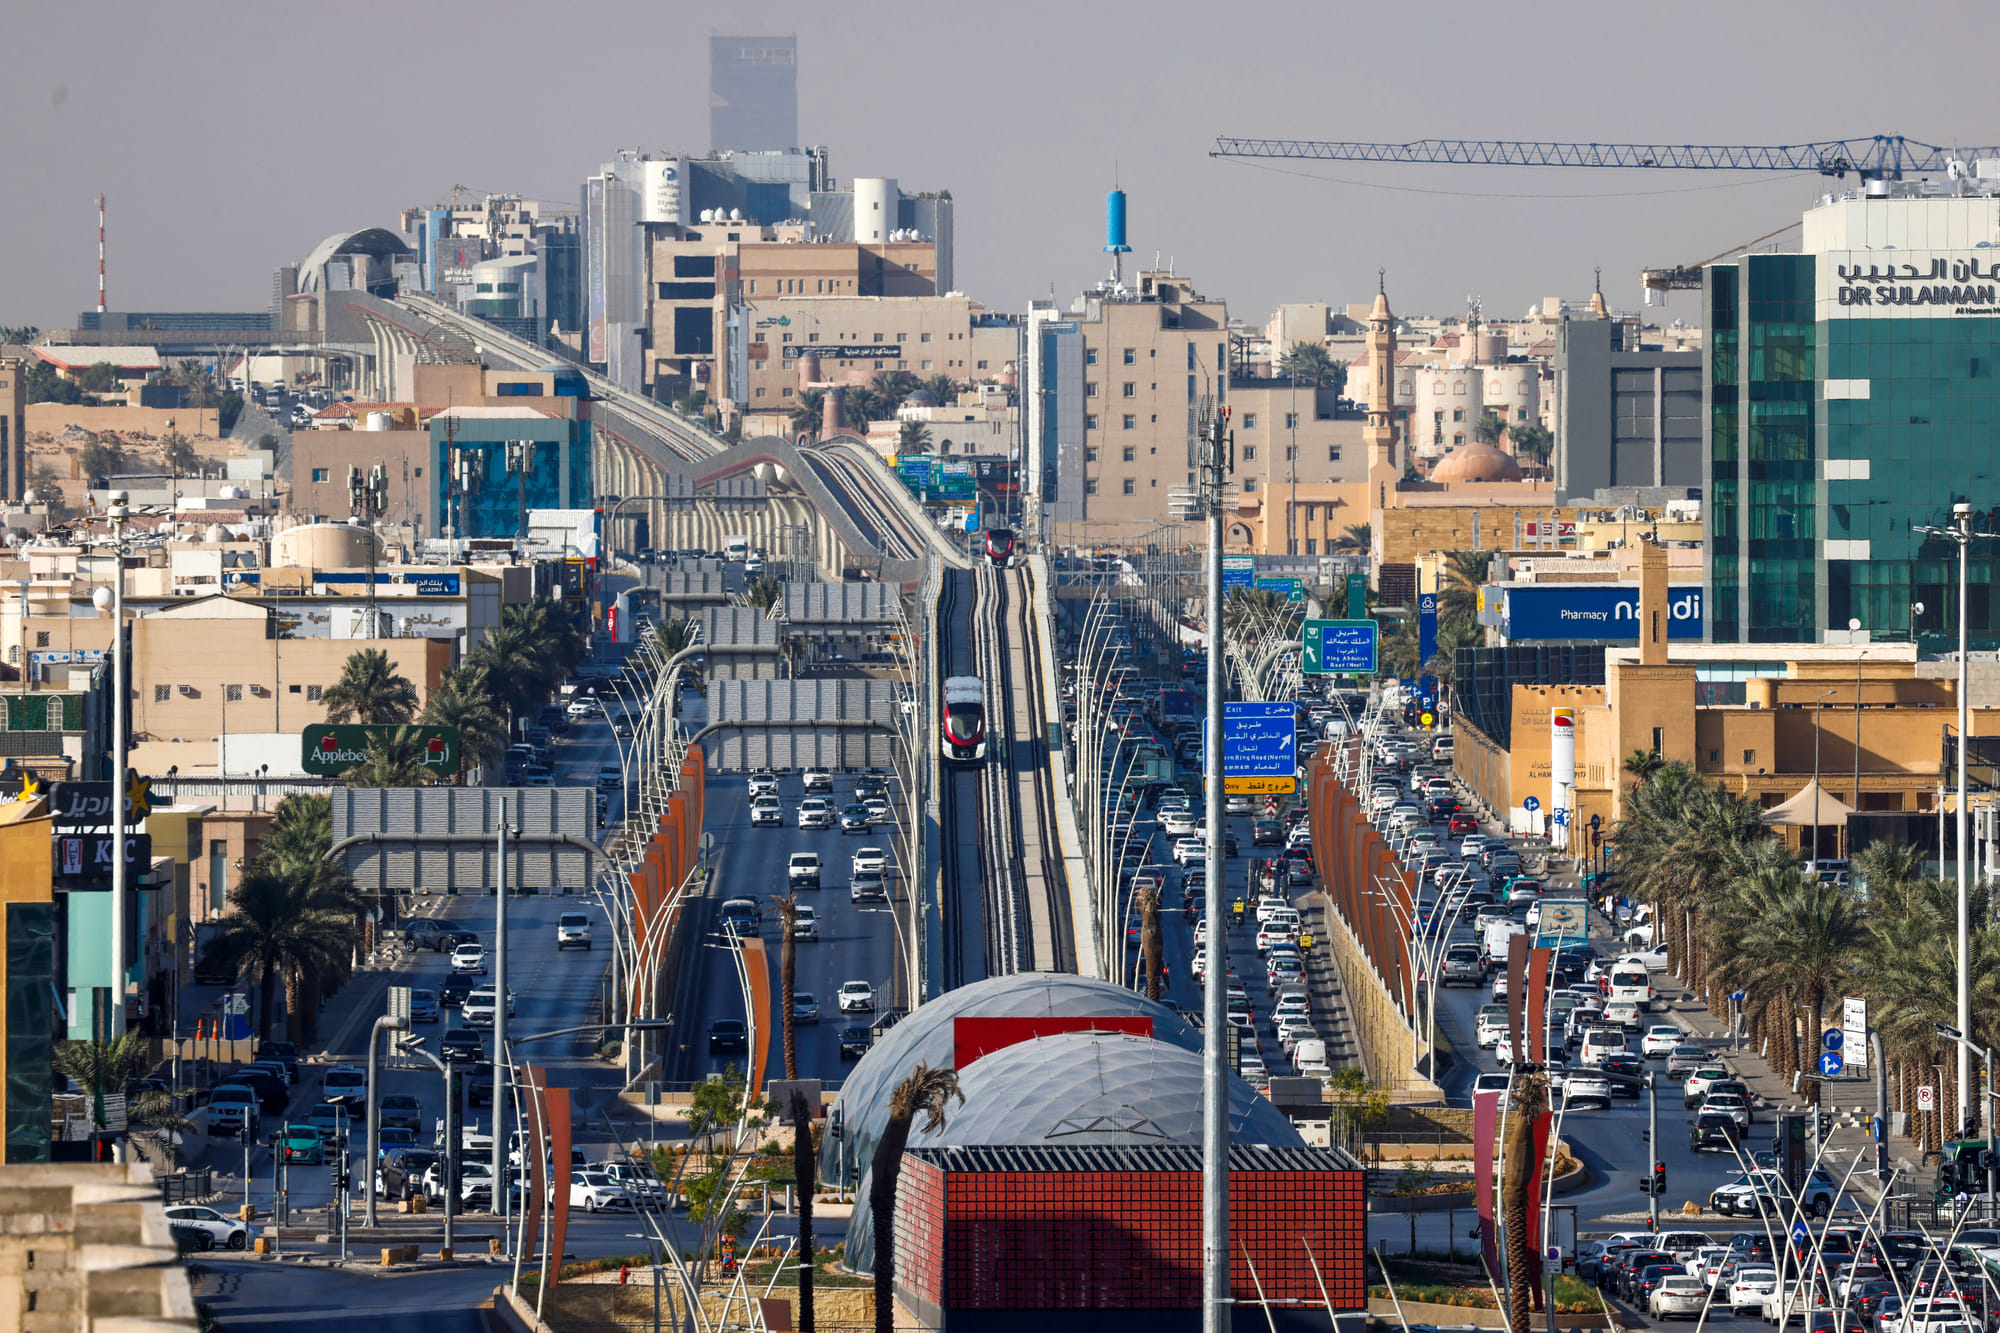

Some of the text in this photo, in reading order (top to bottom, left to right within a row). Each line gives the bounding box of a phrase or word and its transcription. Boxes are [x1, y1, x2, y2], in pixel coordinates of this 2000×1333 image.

[1838, 258, 1948, 285] الحبيب
[1838, 285, 1996, 306] DR SULAIMAN
[1561, 595, 1700, 621] Pharmacy ndi
[1336, 629, 1359, 637] طريق
[1265, 706, 1291, 715] مخرج
[1236, 721, 1261, 730] طريق
[1250, 732, 1280, 741] الدائري
[1254, 763, 1280, 773] الدمام
[1247, 781, 1291, 791] خروج فقط
[94, 839, 136, 863] KC
